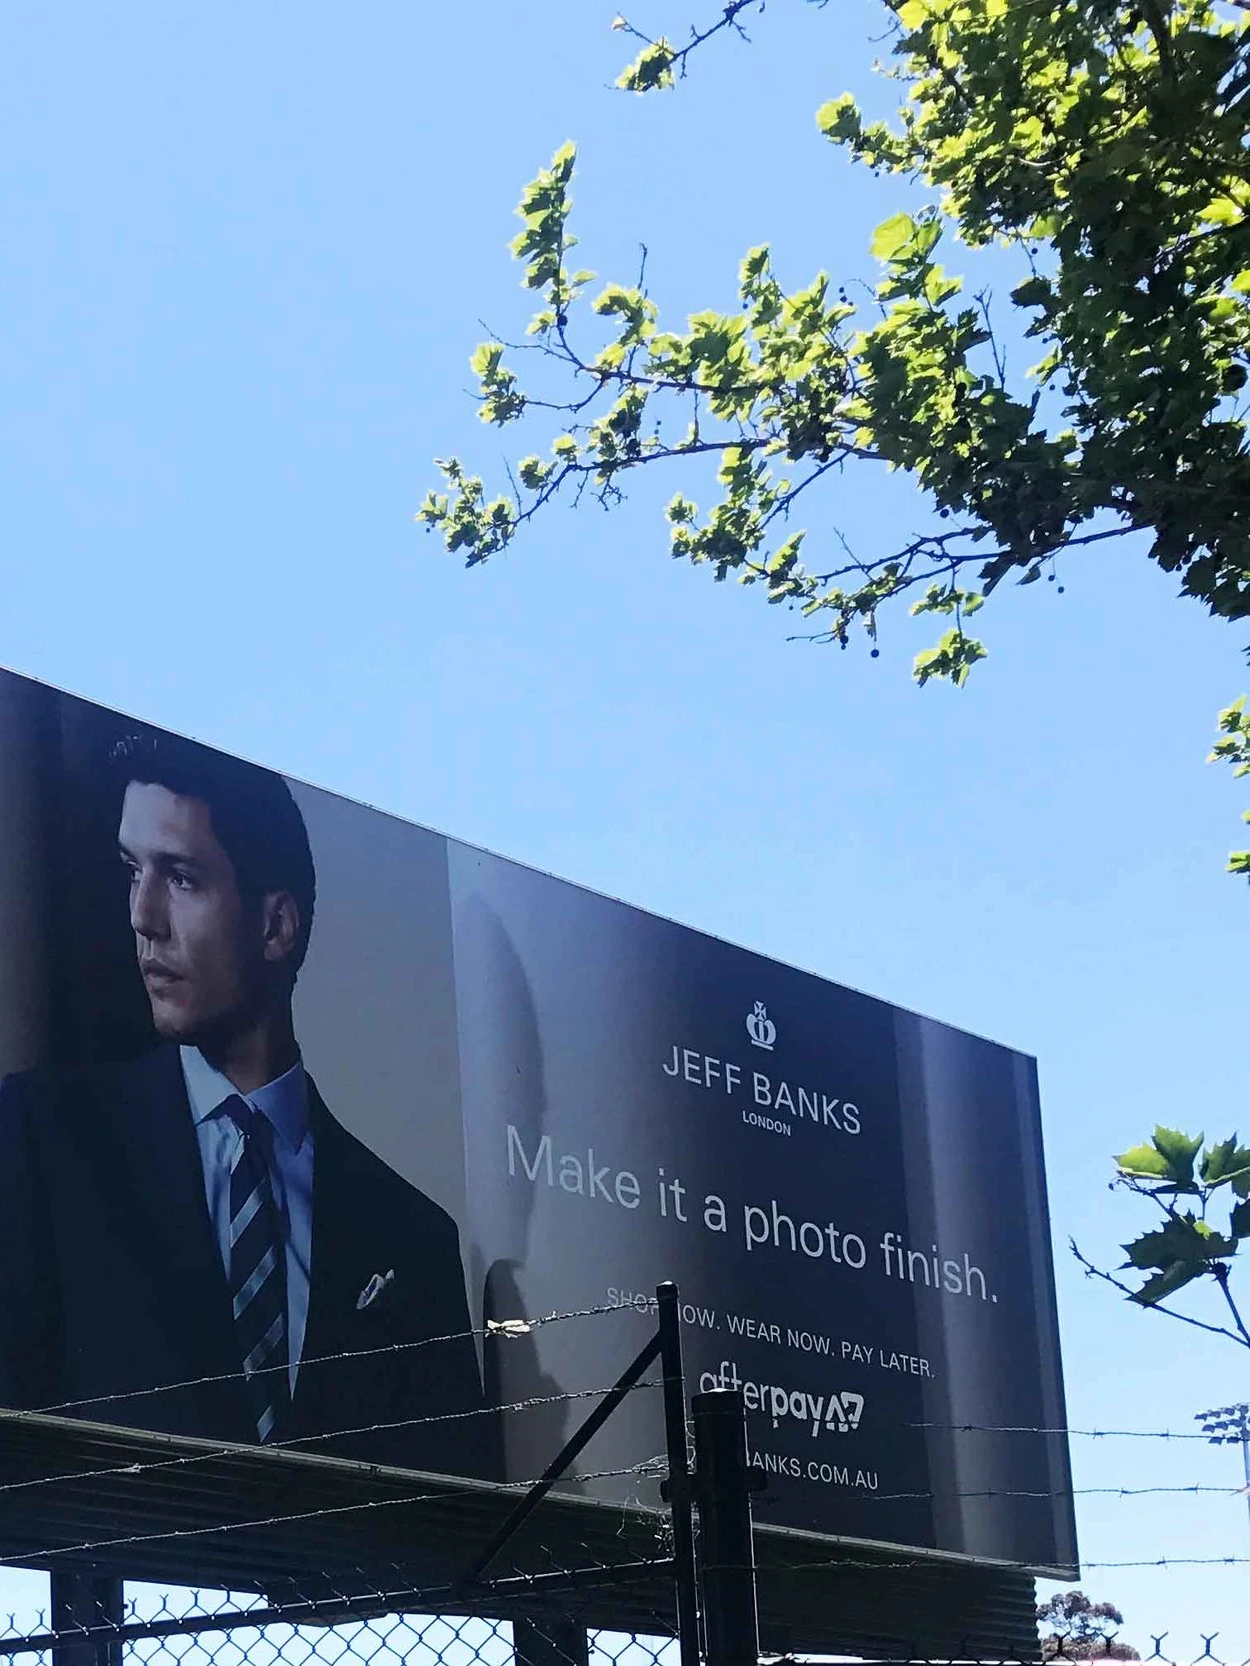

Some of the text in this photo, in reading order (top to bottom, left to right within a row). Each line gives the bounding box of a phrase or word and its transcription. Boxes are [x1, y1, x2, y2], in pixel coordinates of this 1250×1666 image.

[662, 1045, 861, 1135] JEFF BANKS
[742, 1110, 791, 1137] LONDON
[506, 1124, 998, 1303] Make it a photo finish.
[678, 1303, 720, 1330] OW.
[727, 1313, 781, 1345] WEAR
[788, 1328, 835, 1357] NOW.
[841, 1341, 873, 1364] PAY
[879, 1349, 935, 1378] LATER.
[752, 1451, 878, 1490] ANKS.COM.AU
